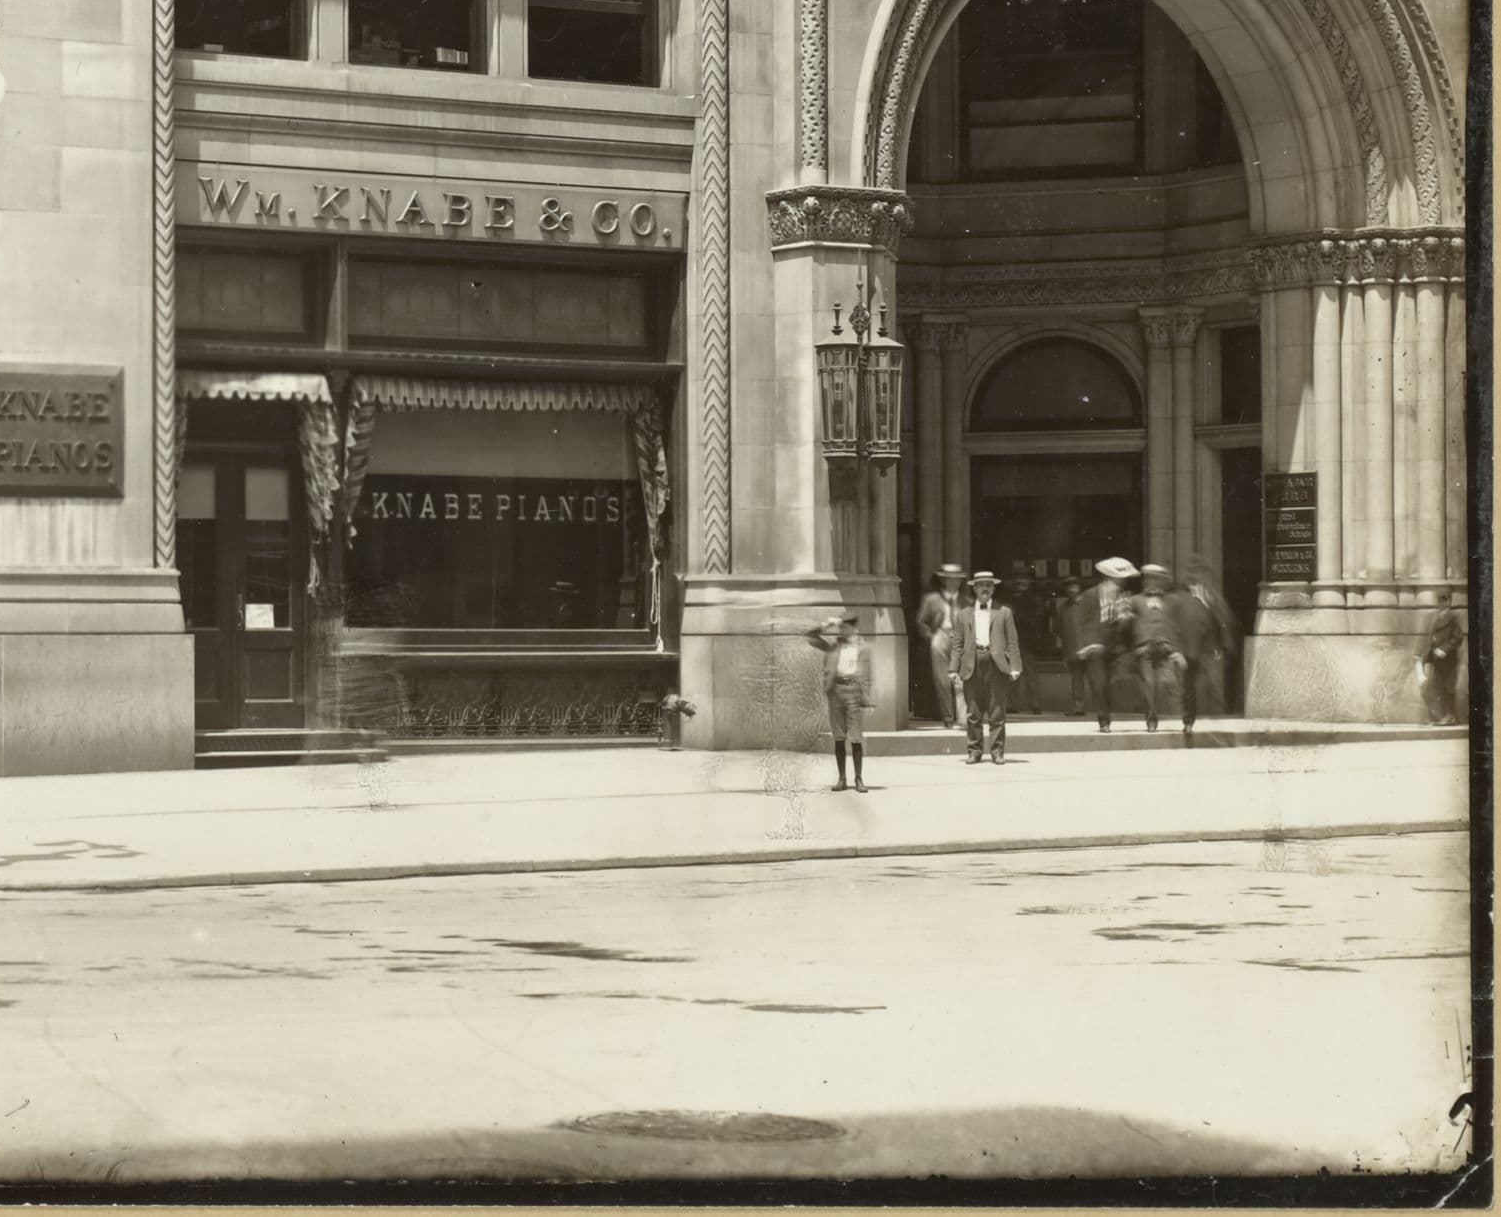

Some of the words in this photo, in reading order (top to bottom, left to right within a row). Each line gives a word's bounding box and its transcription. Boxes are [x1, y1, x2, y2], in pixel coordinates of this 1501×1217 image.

[312, 183, 517, 230] KNABE
[539, 196, 574, 232] &
[372, 491, 483, 520] KNABE
